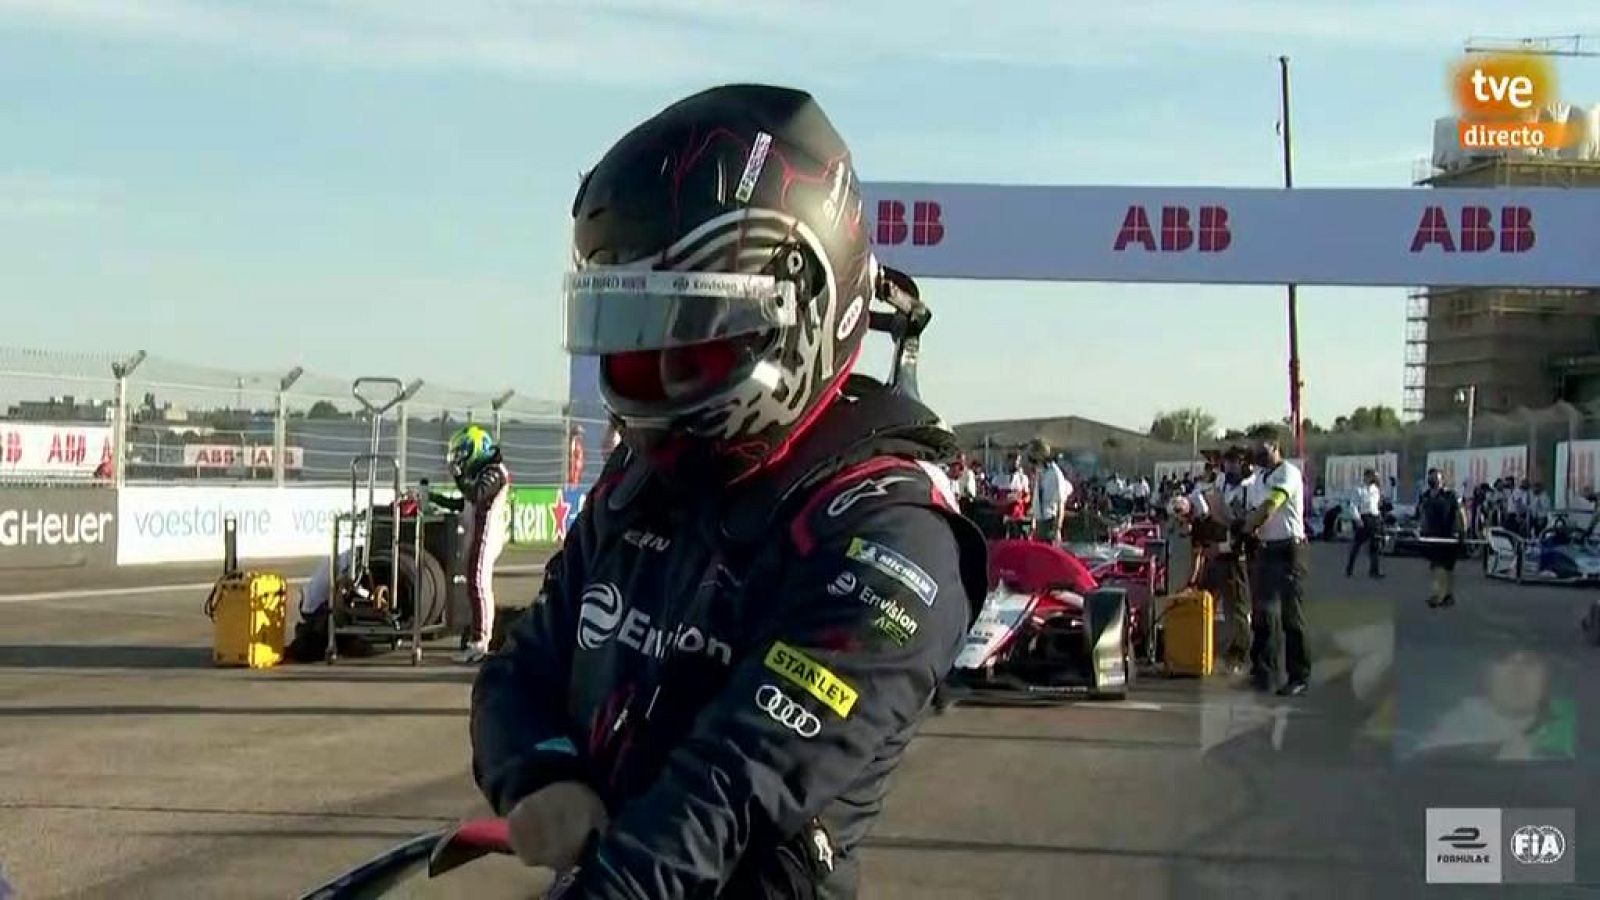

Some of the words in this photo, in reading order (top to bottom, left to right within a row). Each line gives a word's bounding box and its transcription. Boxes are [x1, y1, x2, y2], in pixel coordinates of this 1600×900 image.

[870, 199, 945, 246] BB
[1113, 205, 1232, 252] ABB
[1410, 206, 1536, 253] ABB
[256, 449, 295, 465] AB
[859, 585, 918, 635] Envision
[772, 649, 851, 705] STANLEY
